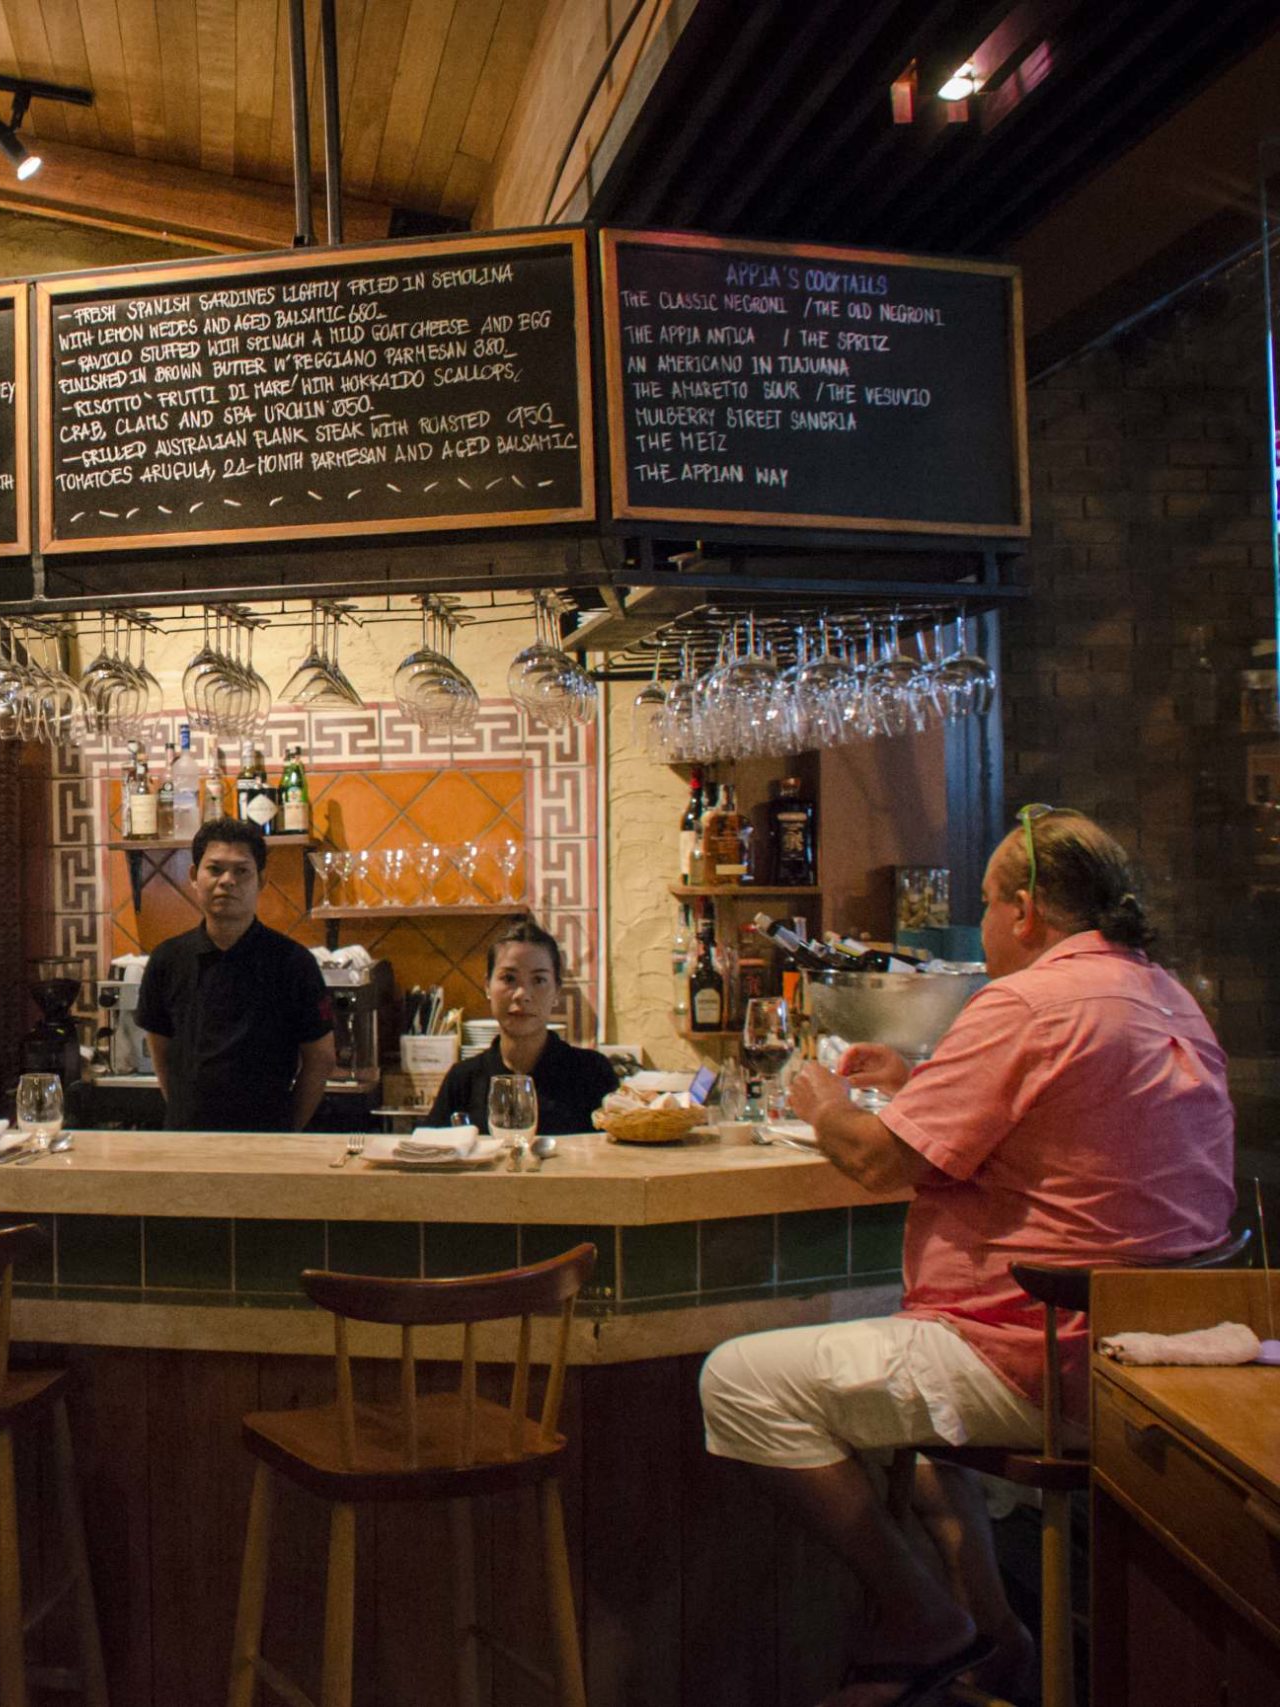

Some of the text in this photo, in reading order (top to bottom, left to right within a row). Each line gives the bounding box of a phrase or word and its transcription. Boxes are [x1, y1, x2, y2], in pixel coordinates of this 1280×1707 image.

[74, 264, 514, 326] FRESH SPANISH SARDINES LIGHTLY FRIED IN SEMOLINA
[726, 263, 888, 295] APPIA'S COCKTAILS
[623, 290, 946, 326] THE CLASSIC NEGRONI THE OLD NEGRONI
[59, 305, 345, 351] WITH LEMON AND AGED BALSAMIC
[78, 310, 552, 372] RAVIOLO STUFFED WITH SPINACH MILD GOAT CHEESE AND EGG
[624, 326, 891, 352] THE APPIA ANTICA THE SPRITZ
[59, 341, 467, 395] FINISHED IN BROWN BUTTER REGGIANO PARMESAN
[627, 355, 850, 375] AN AMERICANO IN TIAJUANA
[74, 370, 425, 418] RISOTTO WITH HOKKAIDO
[632, 381, 931, 407] THE AMARETTO SOUR THE VESUVIO
[115, 400, 325, 436] CLAMS AND SEA URCHIN
[636, 407, 857, 430] MULBERRY STREET SANGRIA
[82, 410, 490, 467] GRILLED AUSTRALIAN FLANK STEAK WITH ROASTED
[636, 432, 728, 453] THE METZ
[57, 433, 577, 491] TOMATOES PARMESAN AND AGED BALSAMIC
[635, 464, 788, 488] THE APPIAN WAY
